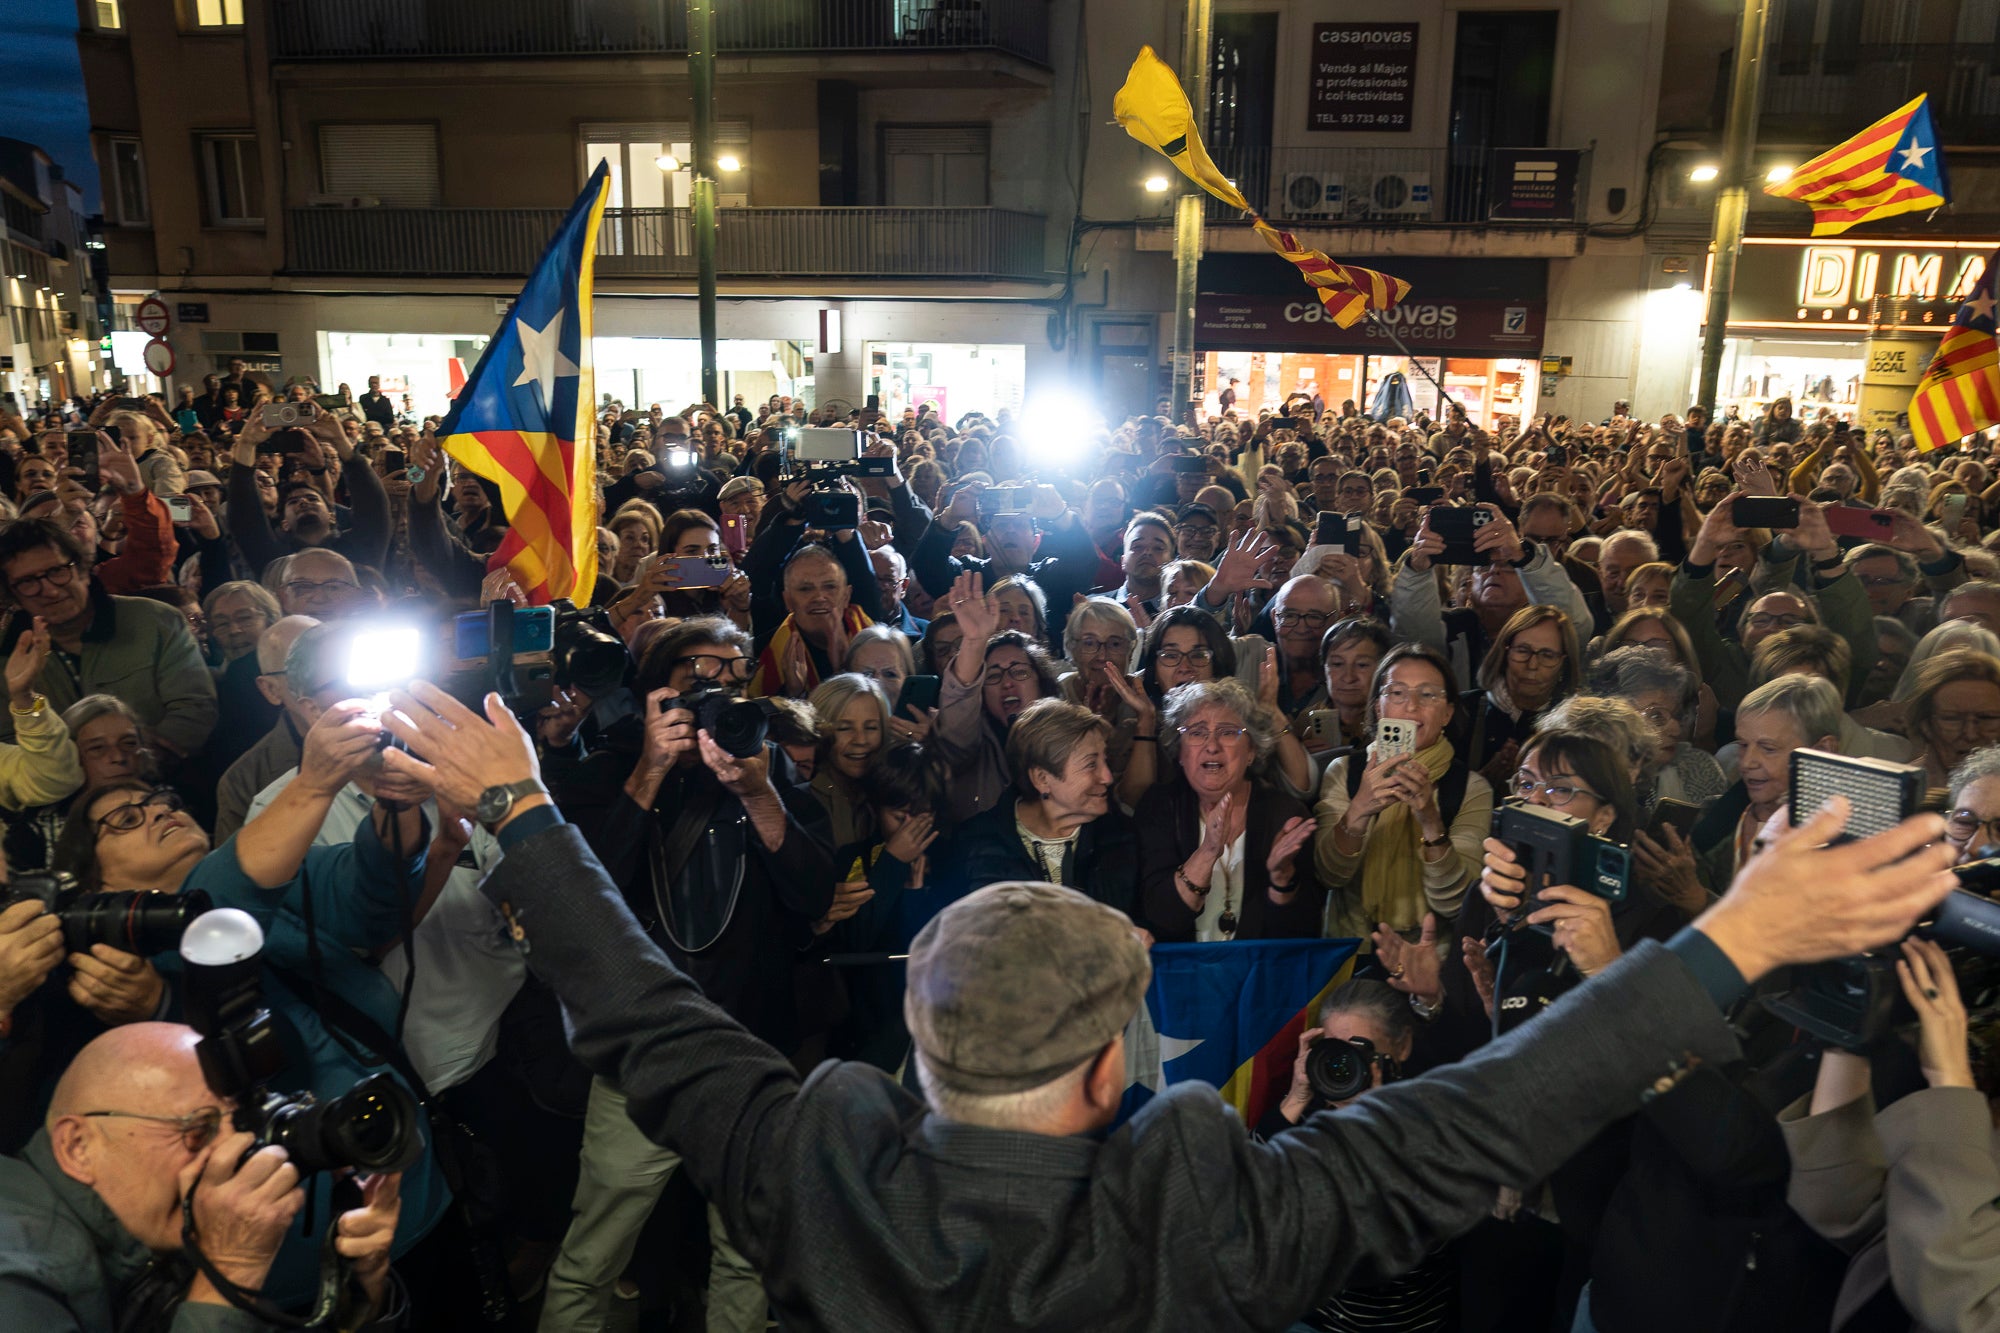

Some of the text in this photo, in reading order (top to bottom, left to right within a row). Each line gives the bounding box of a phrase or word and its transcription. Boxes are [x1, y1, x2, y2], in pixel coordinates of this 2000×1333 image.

[1320, 31, 1412, 43] casanovas
[1320, 63, 1408, 76] Venda al Major
[1316, 77, 1408, 88] a professionals
[1341, 113, 1354, 123] 93
[1356, 113, 1374, 123] 733
[1376, 114, 1390, 123] 40
[1391, 114, 1405, 124] 32
[1874, 351, 1905, 361] LOVE
[1870, 362, 1907, 373] LOCAL
